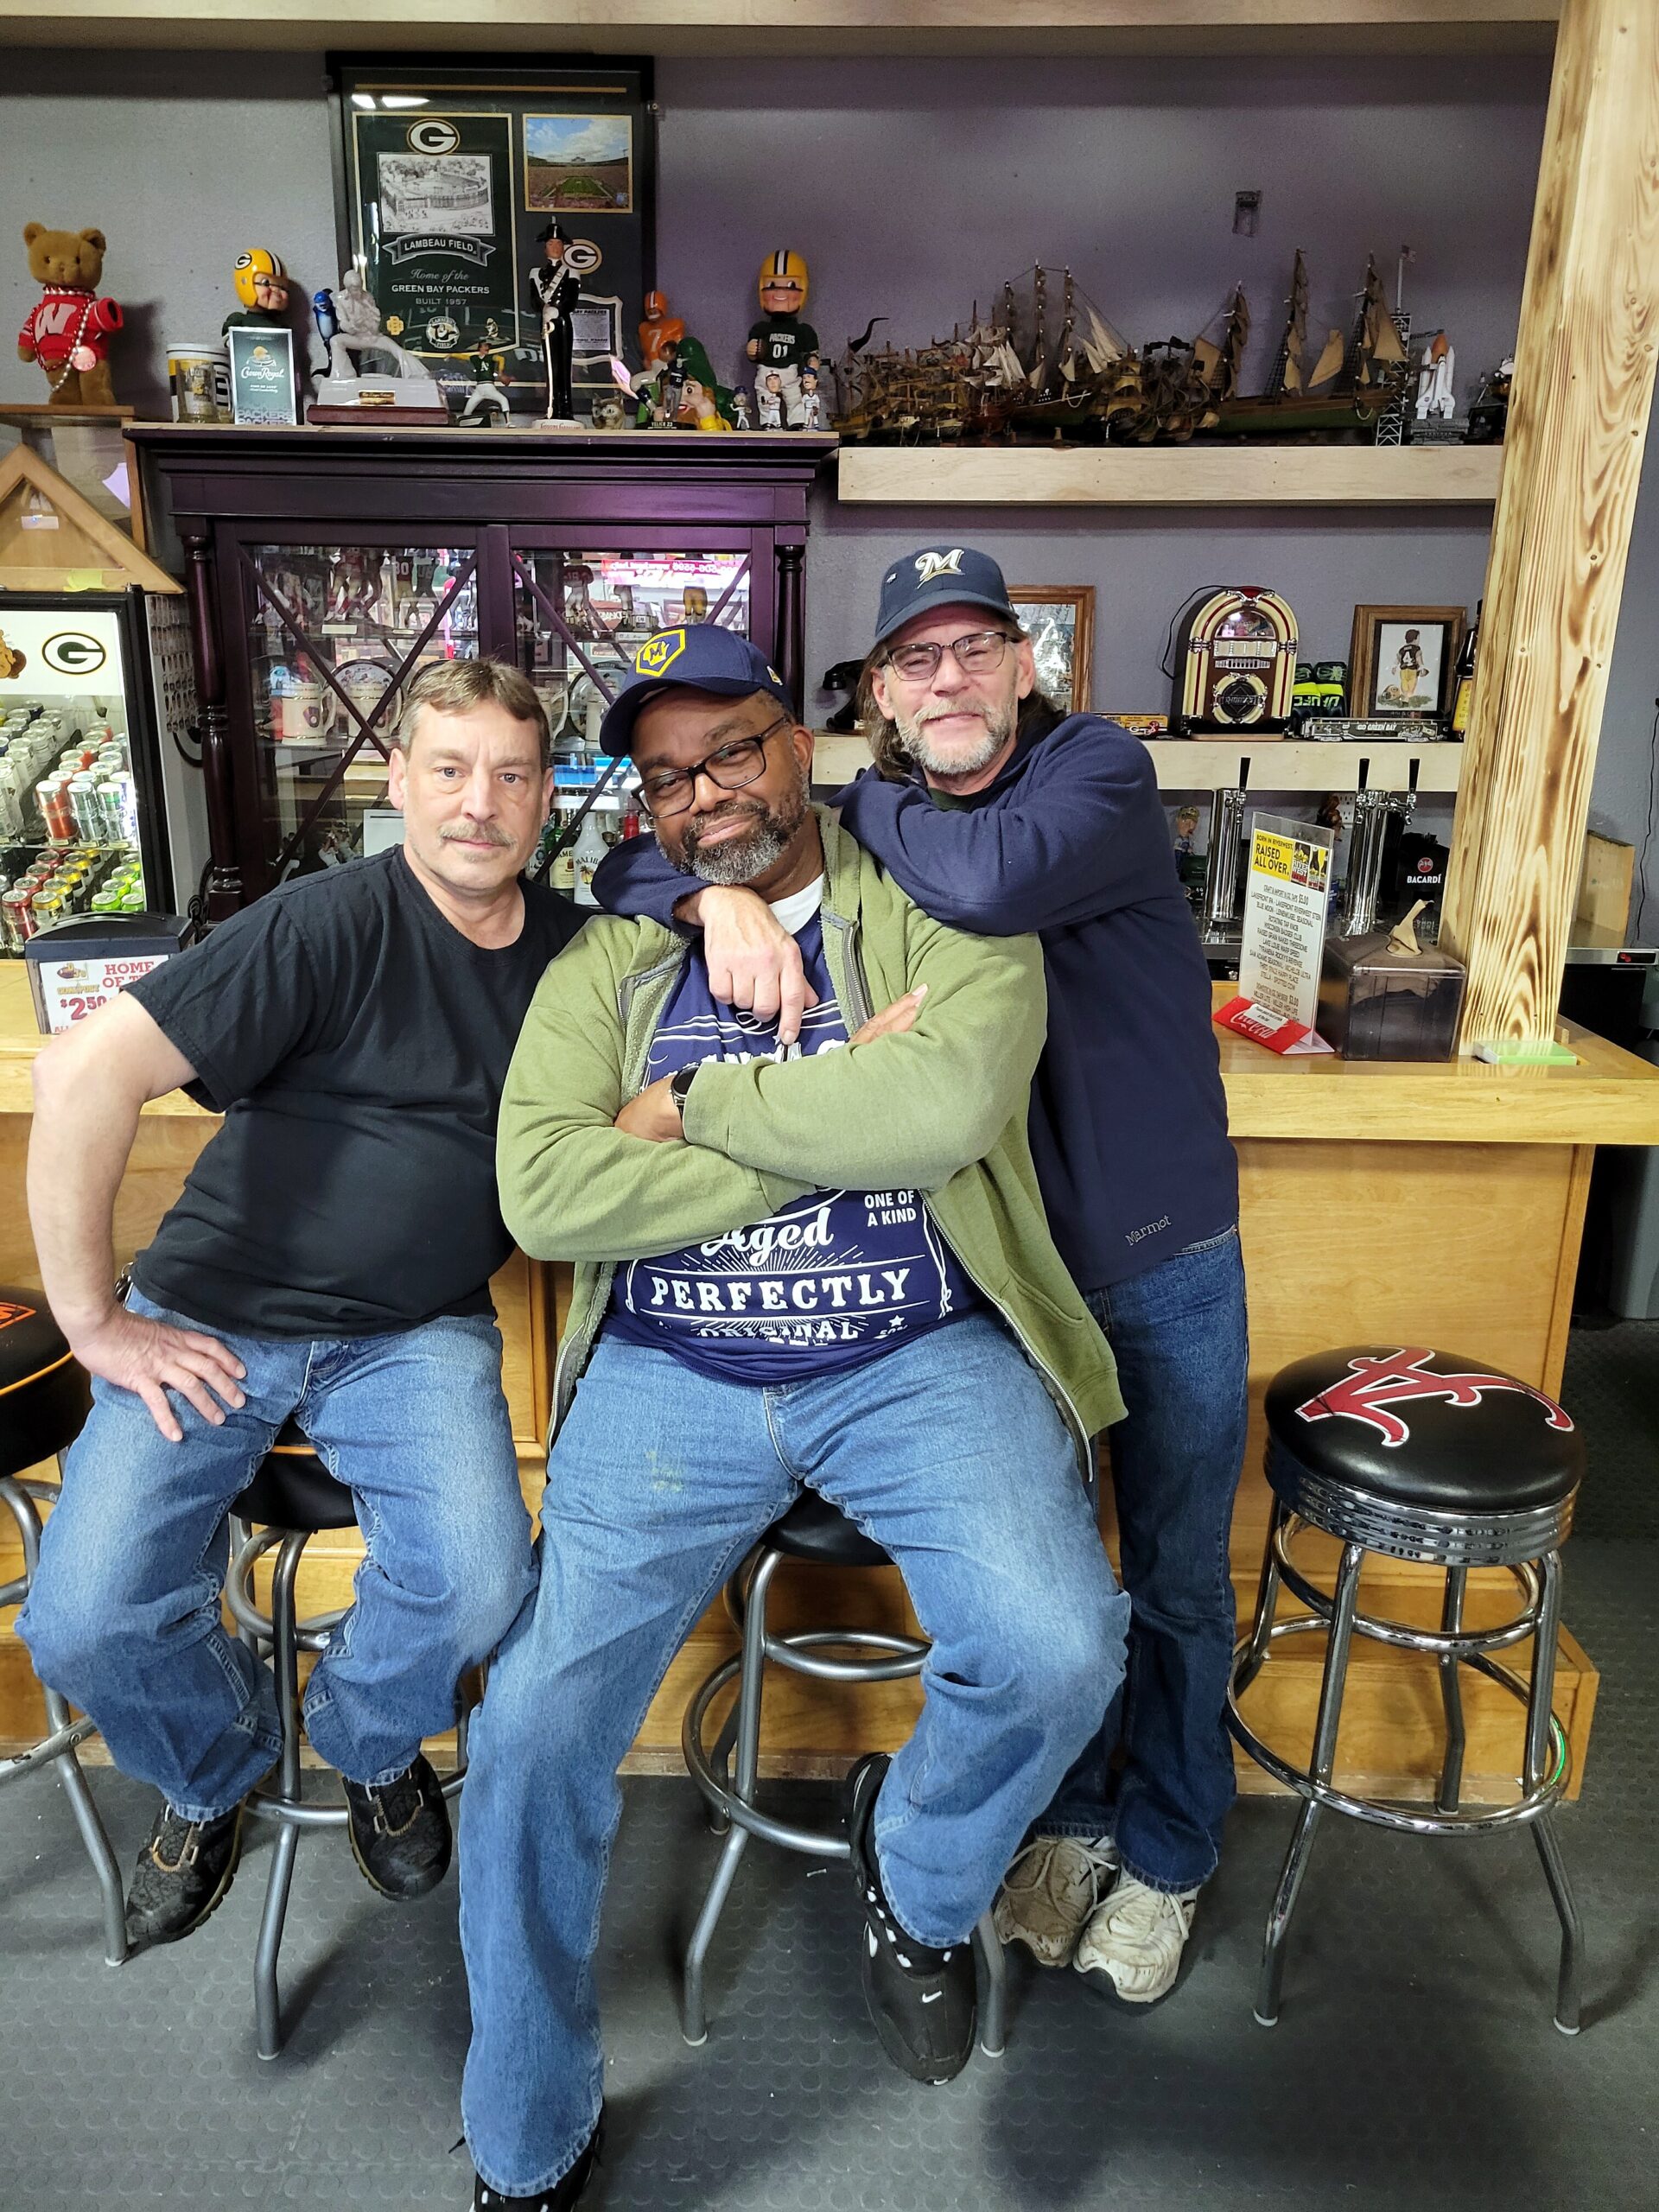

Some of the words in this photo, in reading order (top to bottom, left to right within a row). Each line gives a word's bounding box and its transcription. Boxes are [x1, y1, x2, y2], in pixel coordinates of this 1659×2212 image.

[410, 121, 457, 154] G
[404, 238, 446, 251] LAMBEAU
[448, 239, 474, 252] FIELD
[410, 269, 440, 280] Home
[442, 270, 455, 283] of
[454, 270, 469, 280] the
[391, 284, 424, 293] GREEN
[426, 285, 445, 294] BAY
[241, 366, 262, 379] Crown
[258, 367, 285, 381] Royal
[1255, 843, 1281, 860] RAISED
[1255, 855, 1267, 868] ALL
[1268, 859, 1289, 876] OVER.
[1407, 874, 1442, 884] BACARDÍ
[1251, 891, 1268, 901] LAKEFRONT
[1275, 899, 1293, 911] LAKEFRONT
[1264, 904, 1273, 912] MOON
[1296, 915, 1313, 927] SEASONAL
[102, 976, 124, 988] OF
[864, 1192, 894, 1209] ONE
[898, 1190, 915, 1206] OF
[868, 1211, 879, 1227] A
[882, 1208, 917, 1226] KIND
[700, 1207, 834, 1268] Aged
[1125, 1215, 1172, 1246] Marmot
[650, 1268, 912, 1313] PERFECTLY
